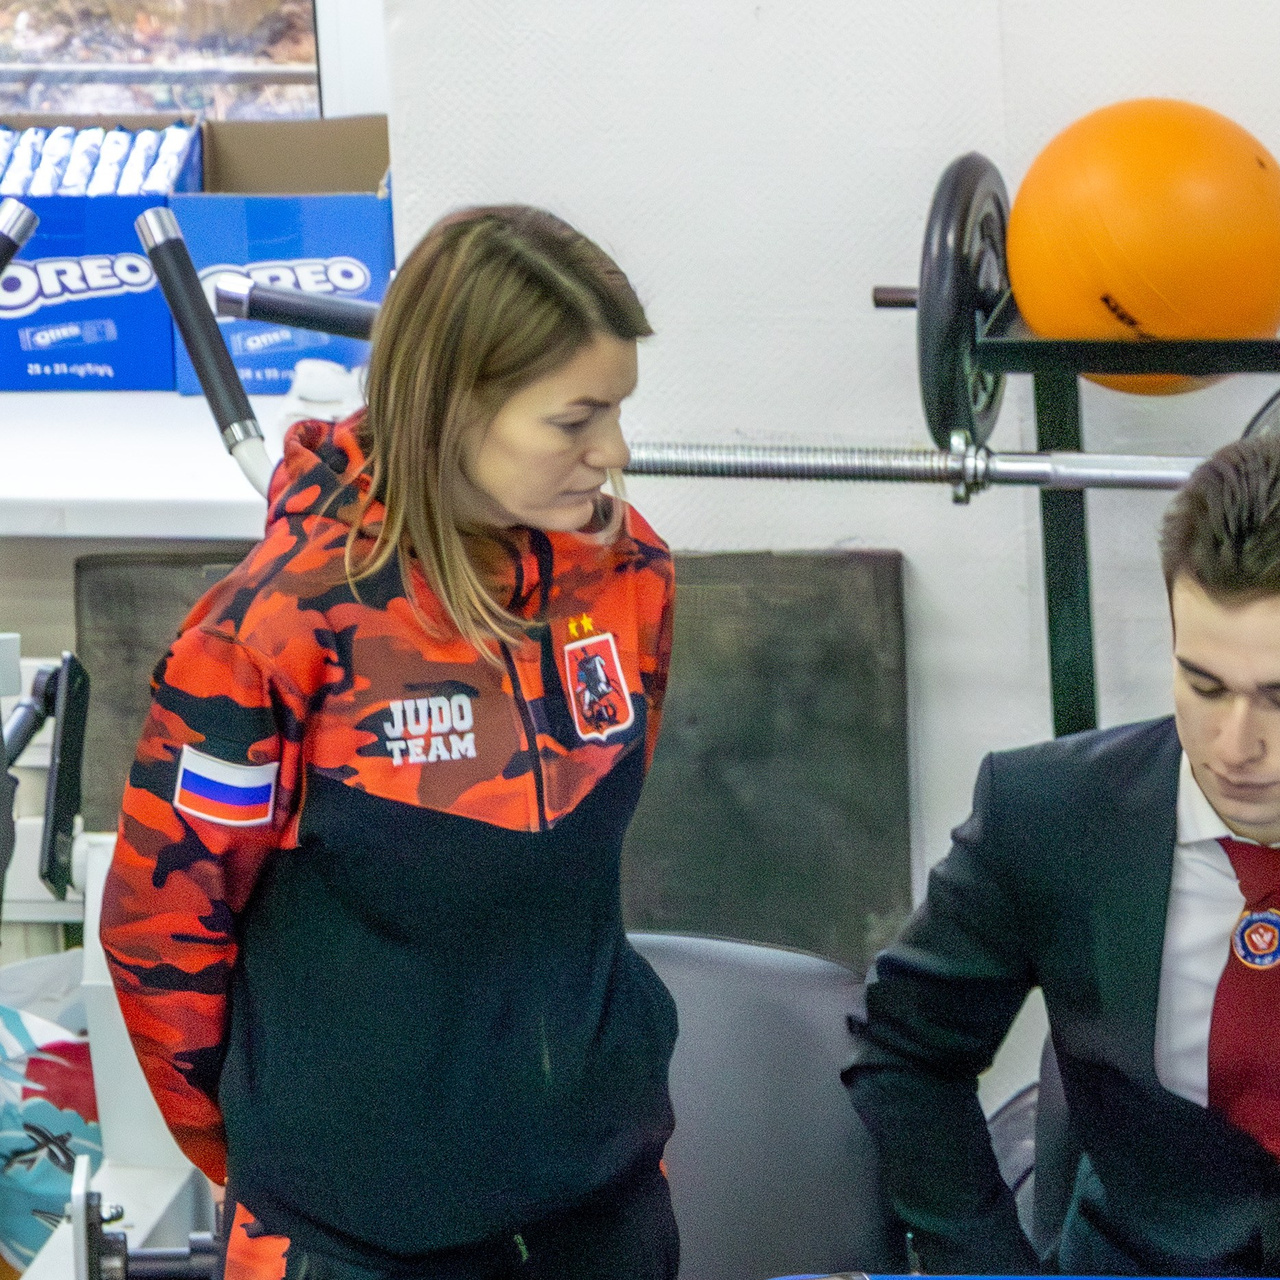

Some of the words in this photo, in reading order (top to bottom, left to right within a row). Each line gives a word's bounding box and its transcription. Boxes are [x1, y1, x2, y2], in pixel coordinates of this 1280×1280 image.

[0, 254, 153, 312] OREO
[383, 694, 474, 738] JUDO
[386, 732, 477, 766] TEAM
